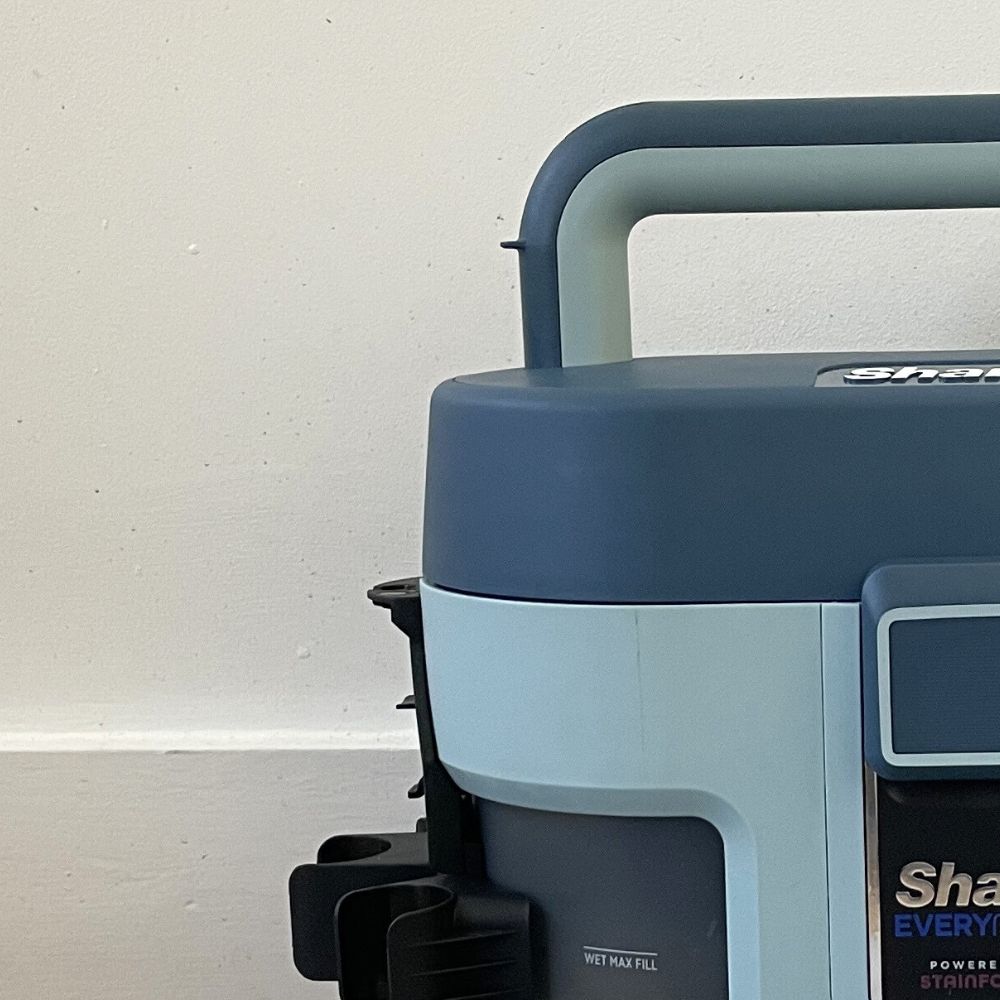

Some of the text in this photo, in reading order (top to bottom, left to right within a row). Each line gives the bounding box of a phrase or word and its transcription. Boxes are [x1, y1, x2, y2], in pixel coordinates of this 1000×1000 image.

[584, 952, 658, 971] WET MAX FILL
